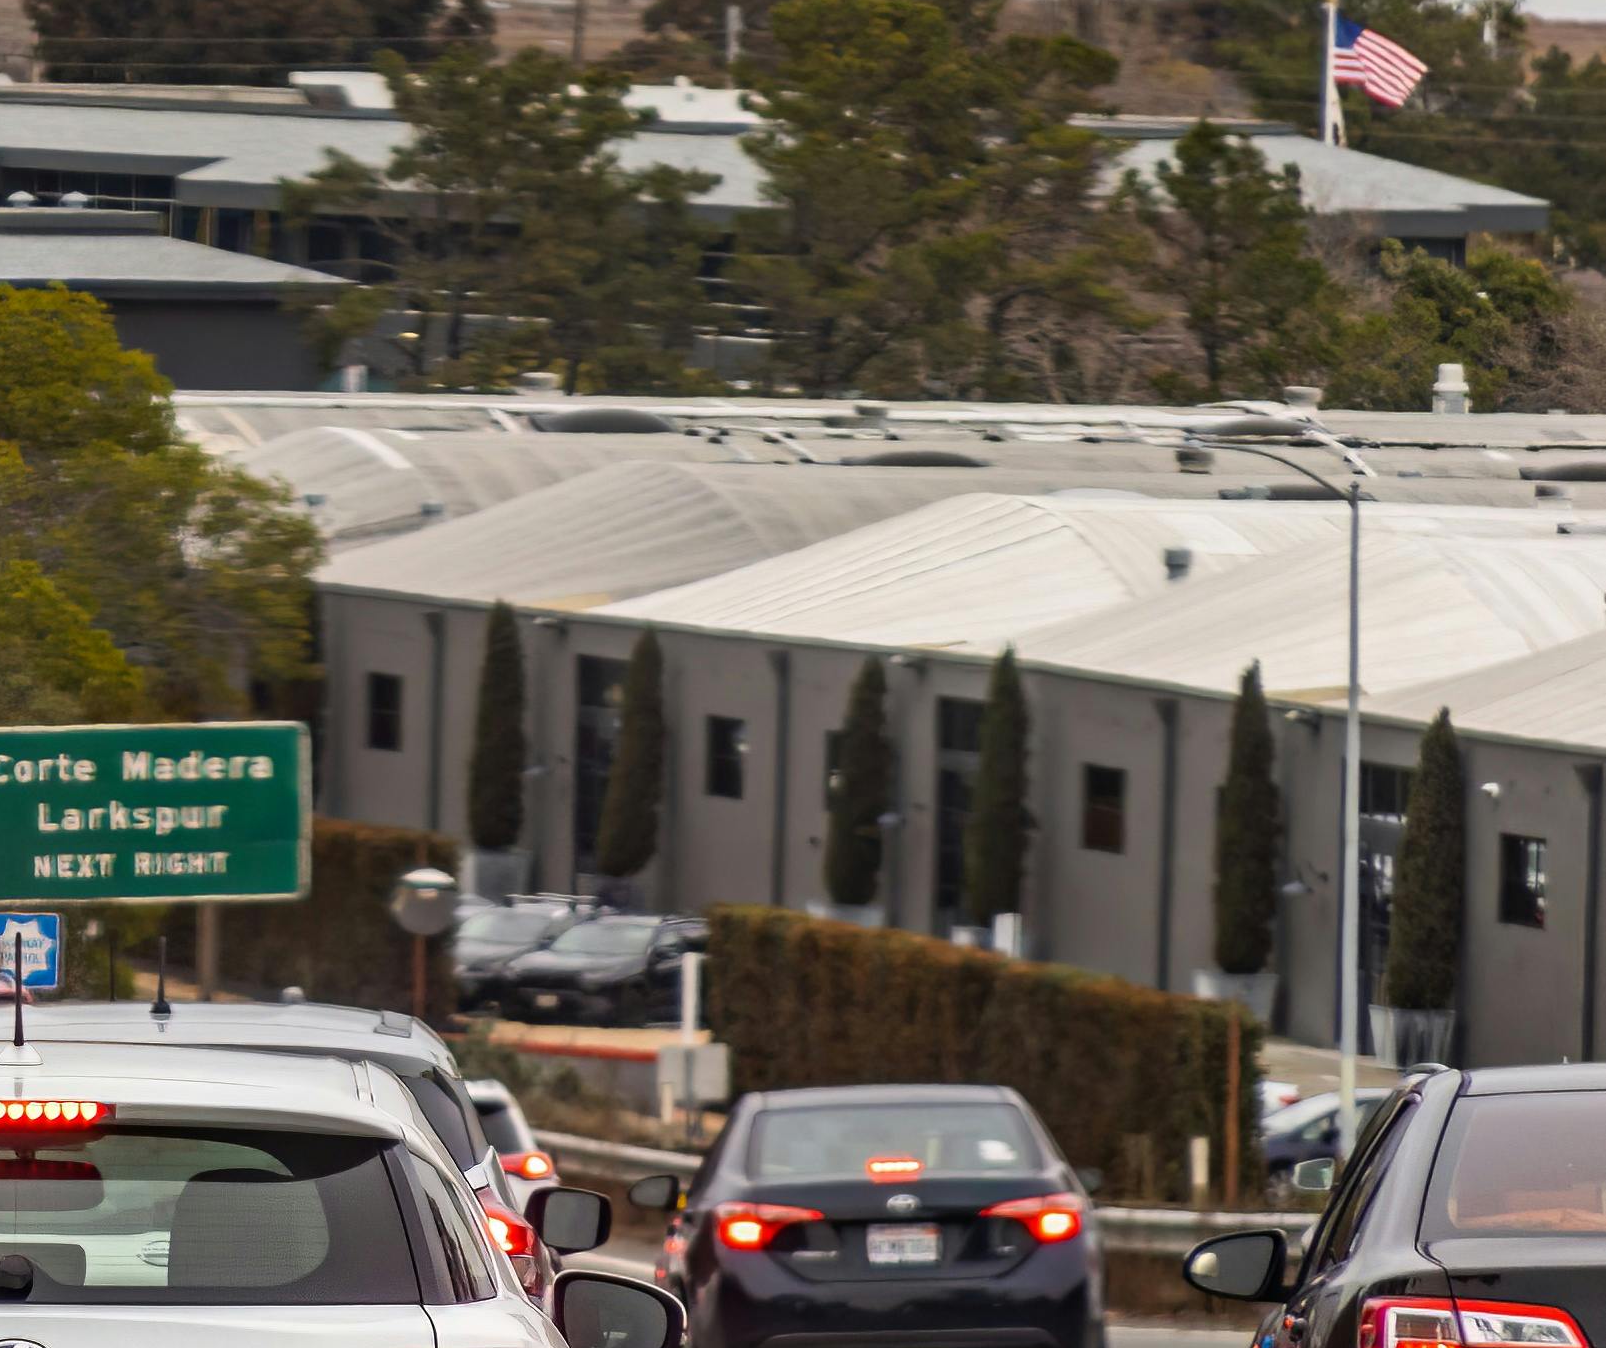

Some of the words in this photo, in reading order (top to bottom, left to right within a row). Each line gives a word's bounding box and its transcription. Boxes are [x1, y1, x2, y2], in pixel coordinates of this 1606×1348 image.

[122, 751, 274, 781] Madera
[38, 800, 228, 835] Larkspur
[34, 853, 117, 878] NEXT
[134, 852, 230, 876] RIGHT
